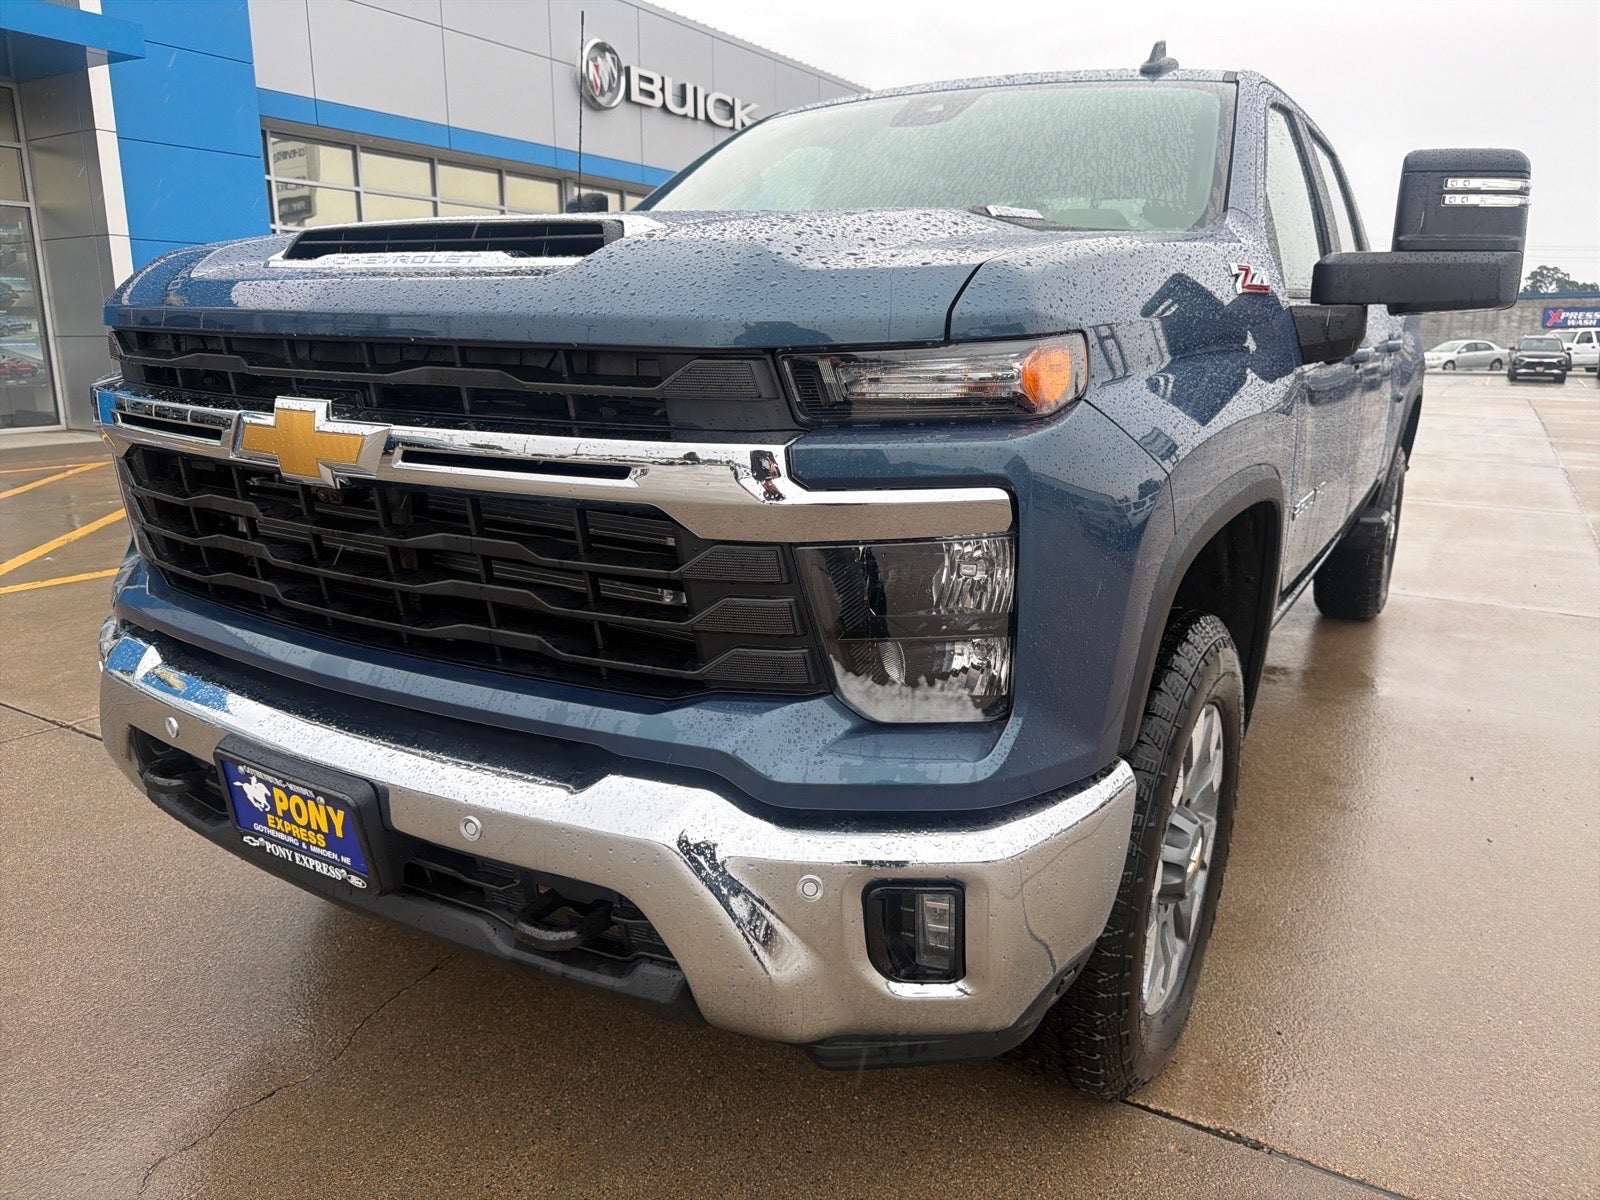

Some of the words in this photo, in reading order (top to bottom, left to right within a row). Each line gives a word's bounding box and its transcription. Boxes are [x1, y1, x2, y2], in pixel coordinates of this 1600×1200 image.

[627, 64, 760, 131] BUICK
[266, 813, 326, 848] EXPRESS
[272, 787, 345, 838] PONY
[253, 823, 300, 846] GOTHENBURG
[341, 855, 352, 866] NE
[265, 841, 293, 862] PONY
[294, 852, 343, 881] EXPRESS
